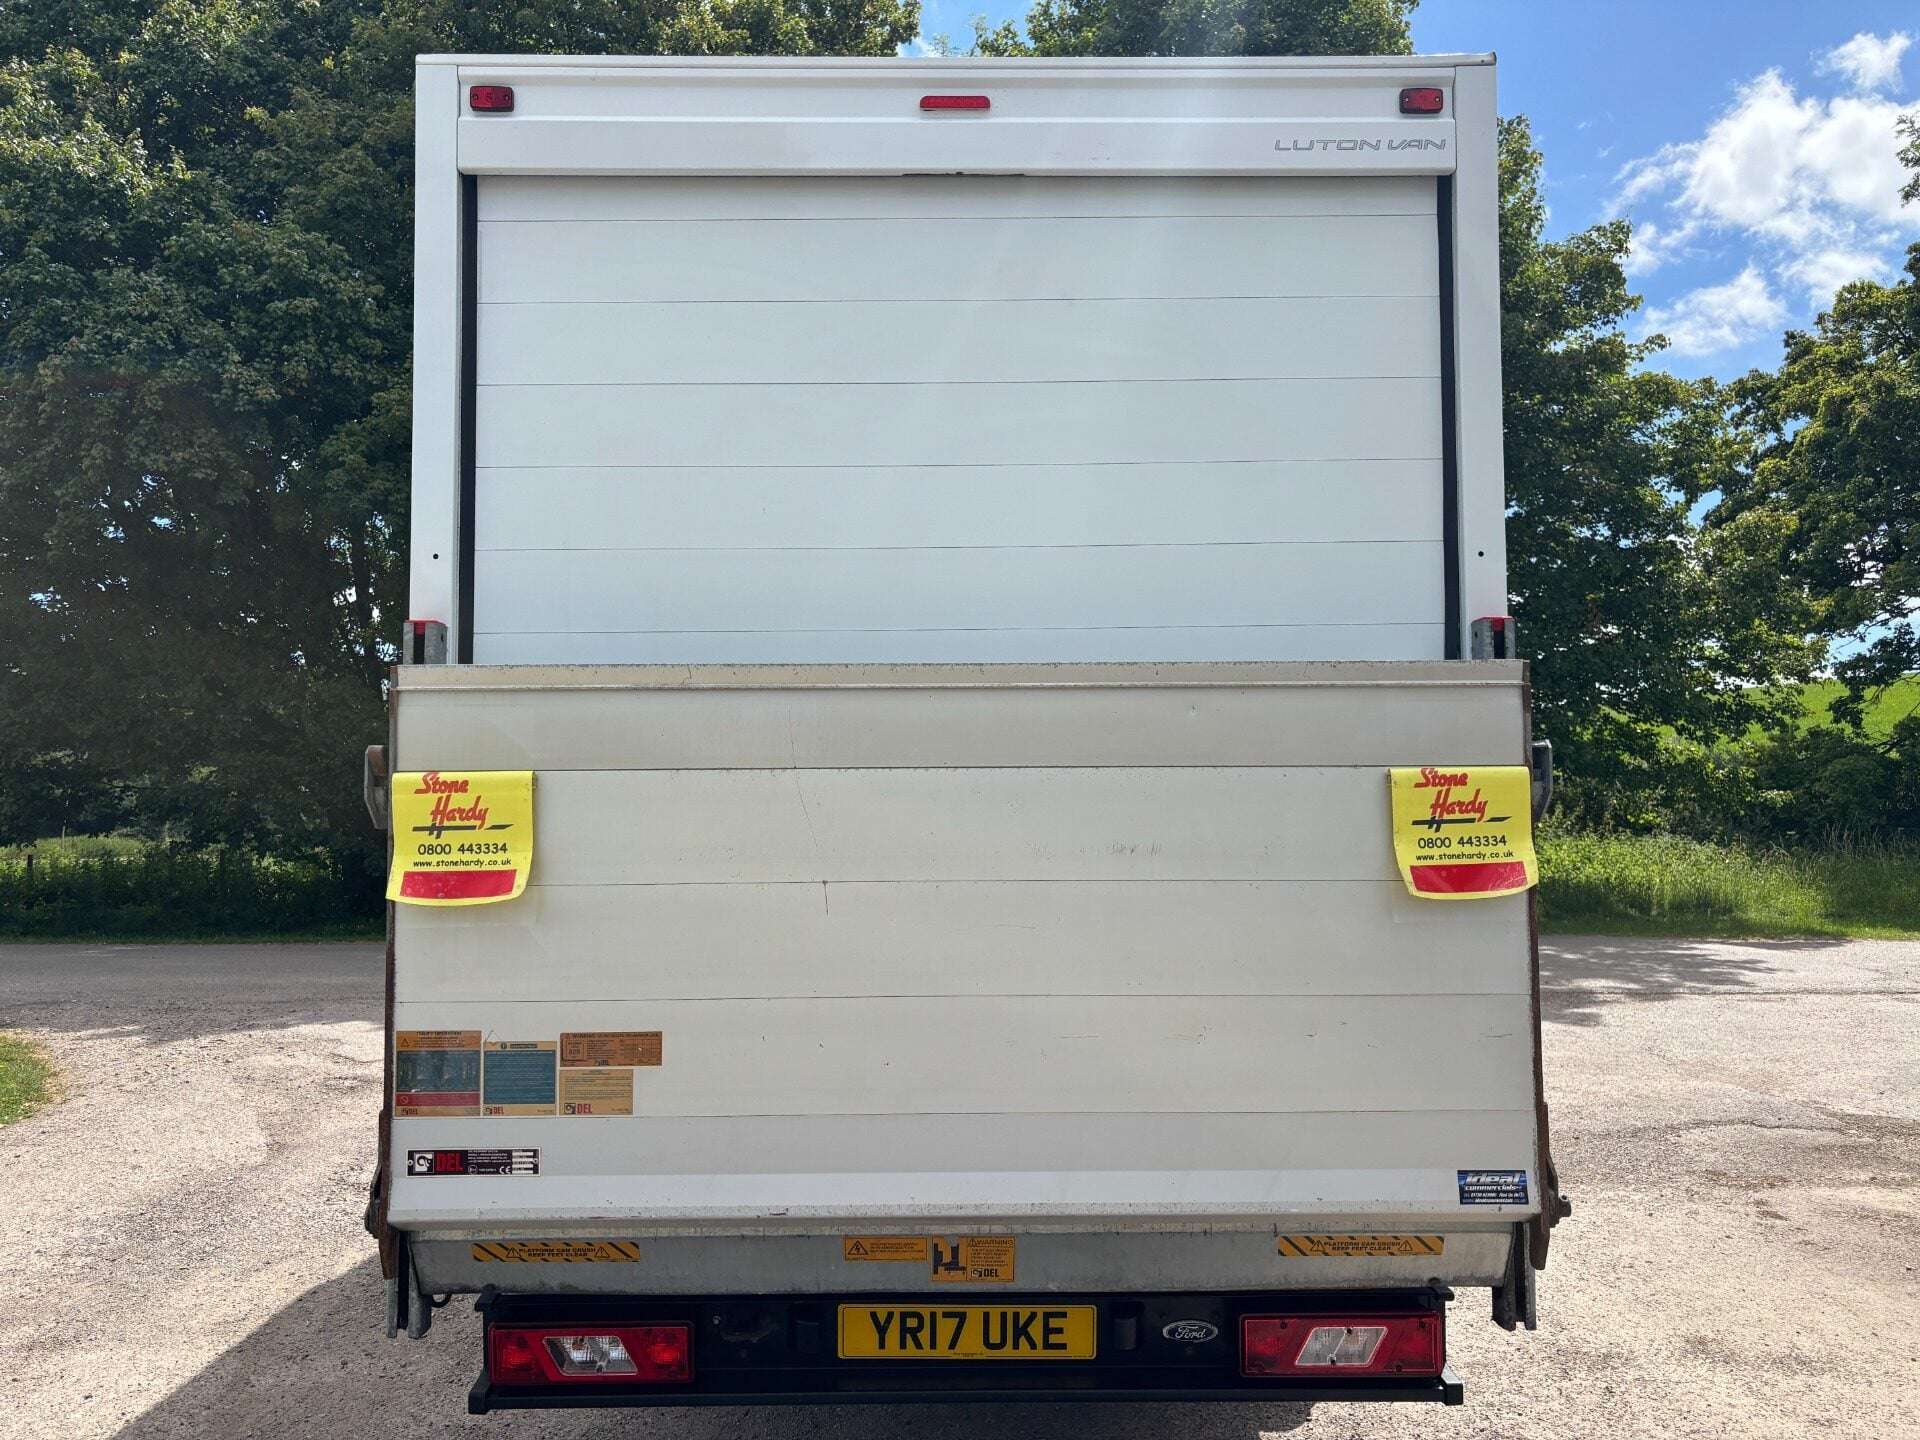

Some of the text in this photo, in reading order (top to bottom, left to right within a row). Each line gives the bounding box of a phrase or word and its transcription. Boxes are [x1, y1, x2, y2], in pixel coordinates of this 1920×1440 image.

[1274, 139, 1446, 151] LUTON VAN
[414, 770, 469, 794] Stone
[1413, 768, 1469, 788] Stone
[1429, 788, 1488, 822] Hardy
[430, 794, 489, 830] Hardy
[417, 842, 508, 855] 0800 443334
[1417, 835, 1507, 849] 0800 443334
[1415, 850, 1514, 861] www.stonehardy.co.uk
[413, 858, 511, 868] www.stonehardy.co.uk
[493, 1106, 504, 1115] DEL
[577, 1103, 592, 1114] DEL
[436, 1152, 463, 1171] DEL
[499, 1166, 511, 1174] CE
[983, 1268, 999, 1278] DEL
[869, 1311, 1068, 1350] YR17 UKE
[1175, 1325, 1206, 1339] Ford
